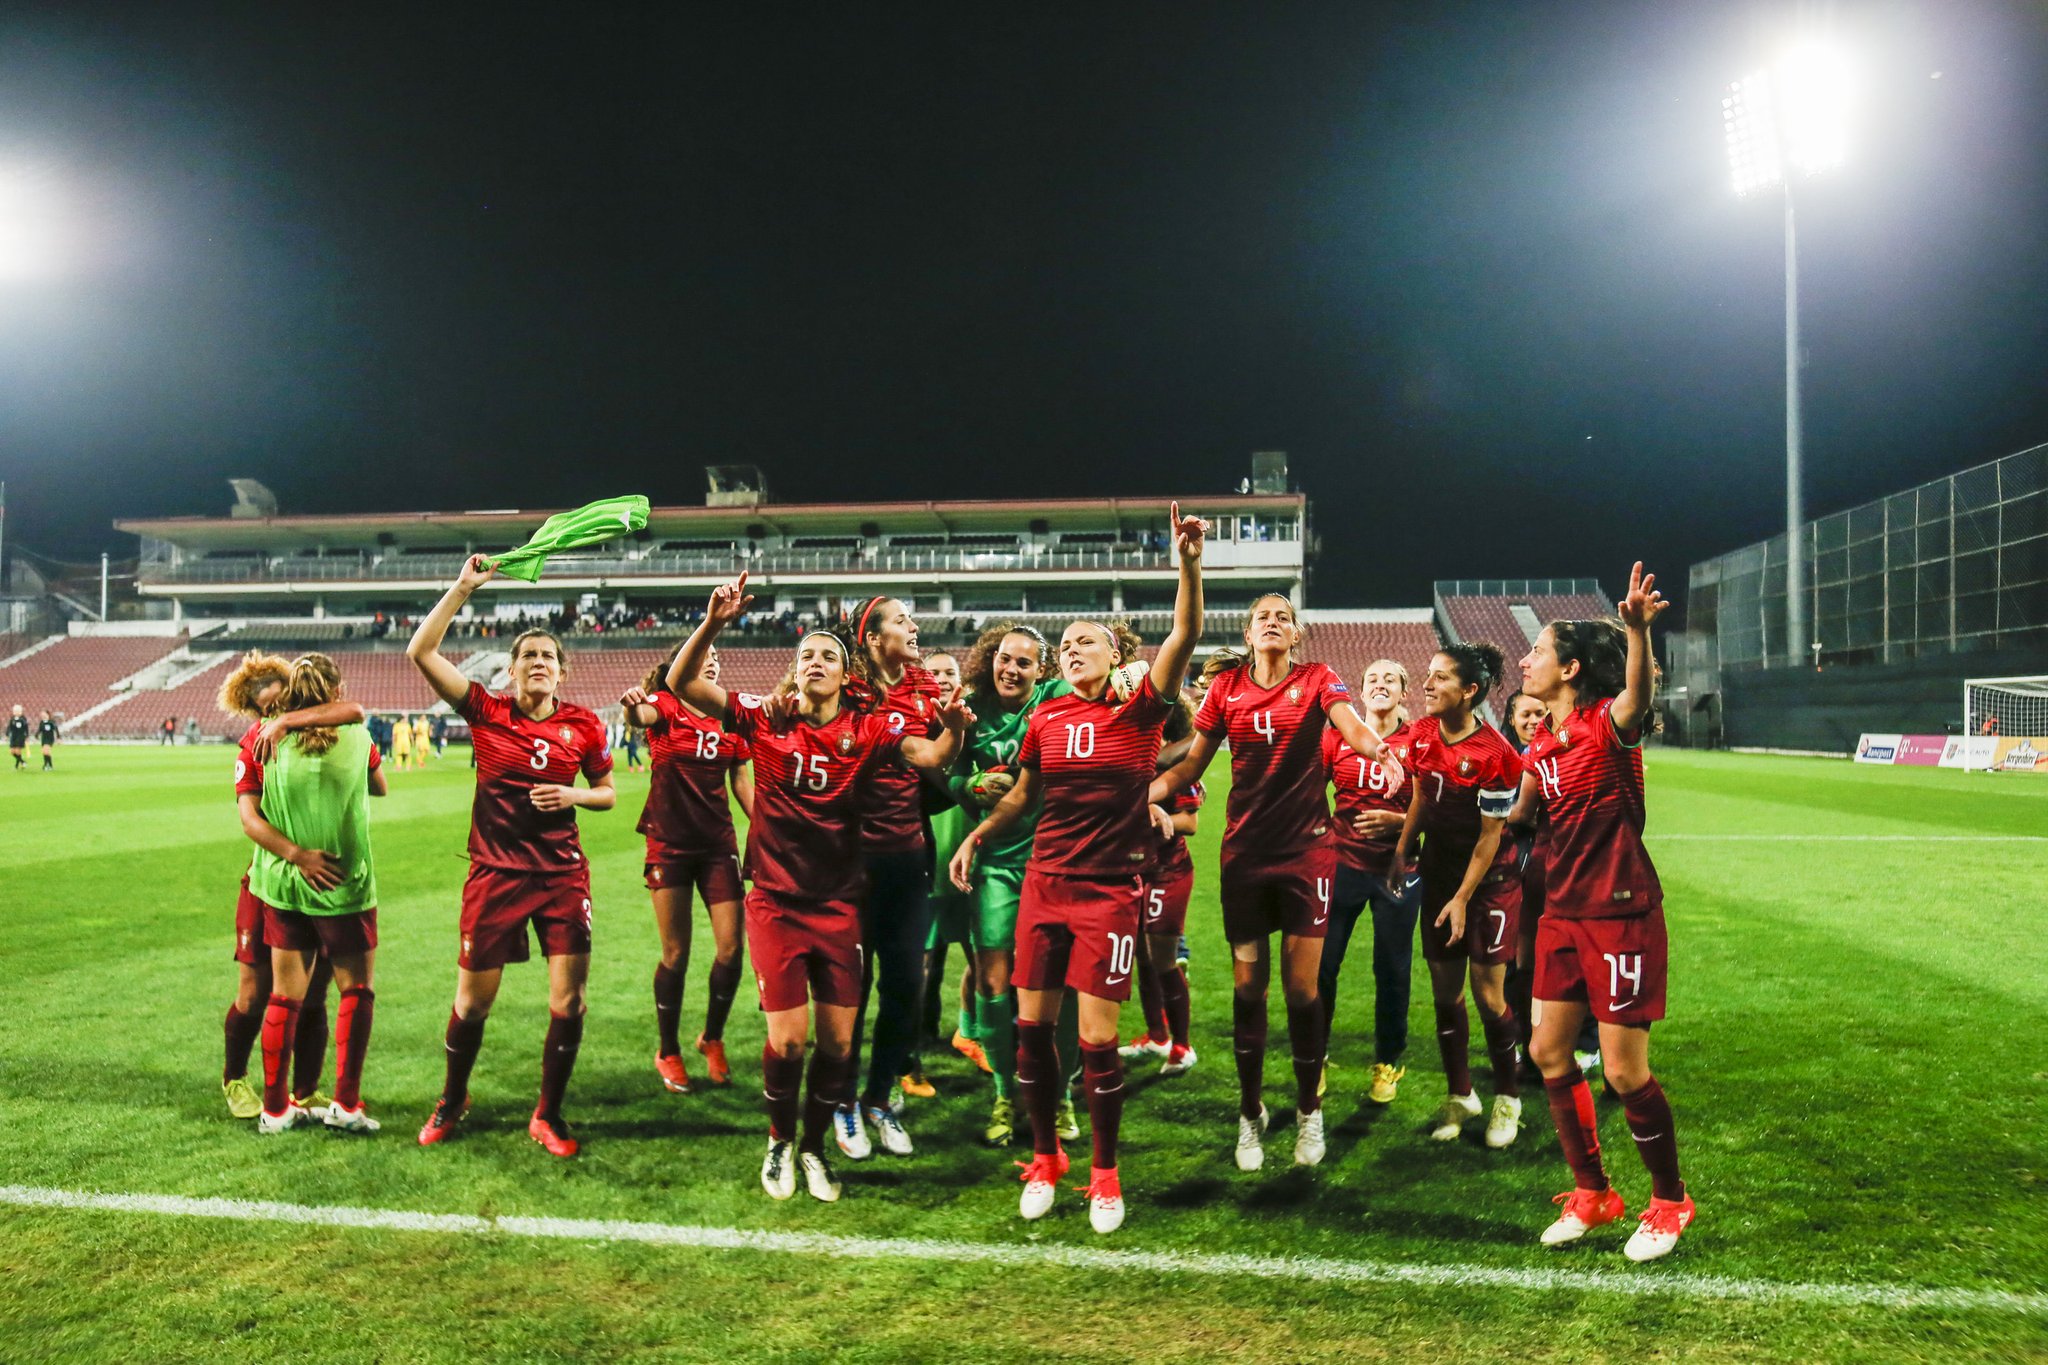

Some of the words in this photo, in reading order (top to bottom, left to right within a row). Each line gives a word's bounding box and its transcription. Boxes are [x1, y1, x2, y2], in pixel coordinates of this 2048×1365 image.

[695, 729, 720, 760] 13
[1065, 722, 1095, 759] 10
[1254, 711, 1276, 745] 4
[530, 739, 551, 770] 3
[793, 751, 829, 791] 15
[1356, 757, 1385, 790] 19
[1431, 771, 1444, 803] 7
[1534, 757, 1562, 800] 14
[1148, 888, 1165, 917] 5
[1317, 877, 1330, 915] 4
[582, 898, 593, 931] 3
[1489, 909, 1506, 945] 7
[1107, 932, 1134, 975] 10
[1603, 953, 1642, 997] 14
